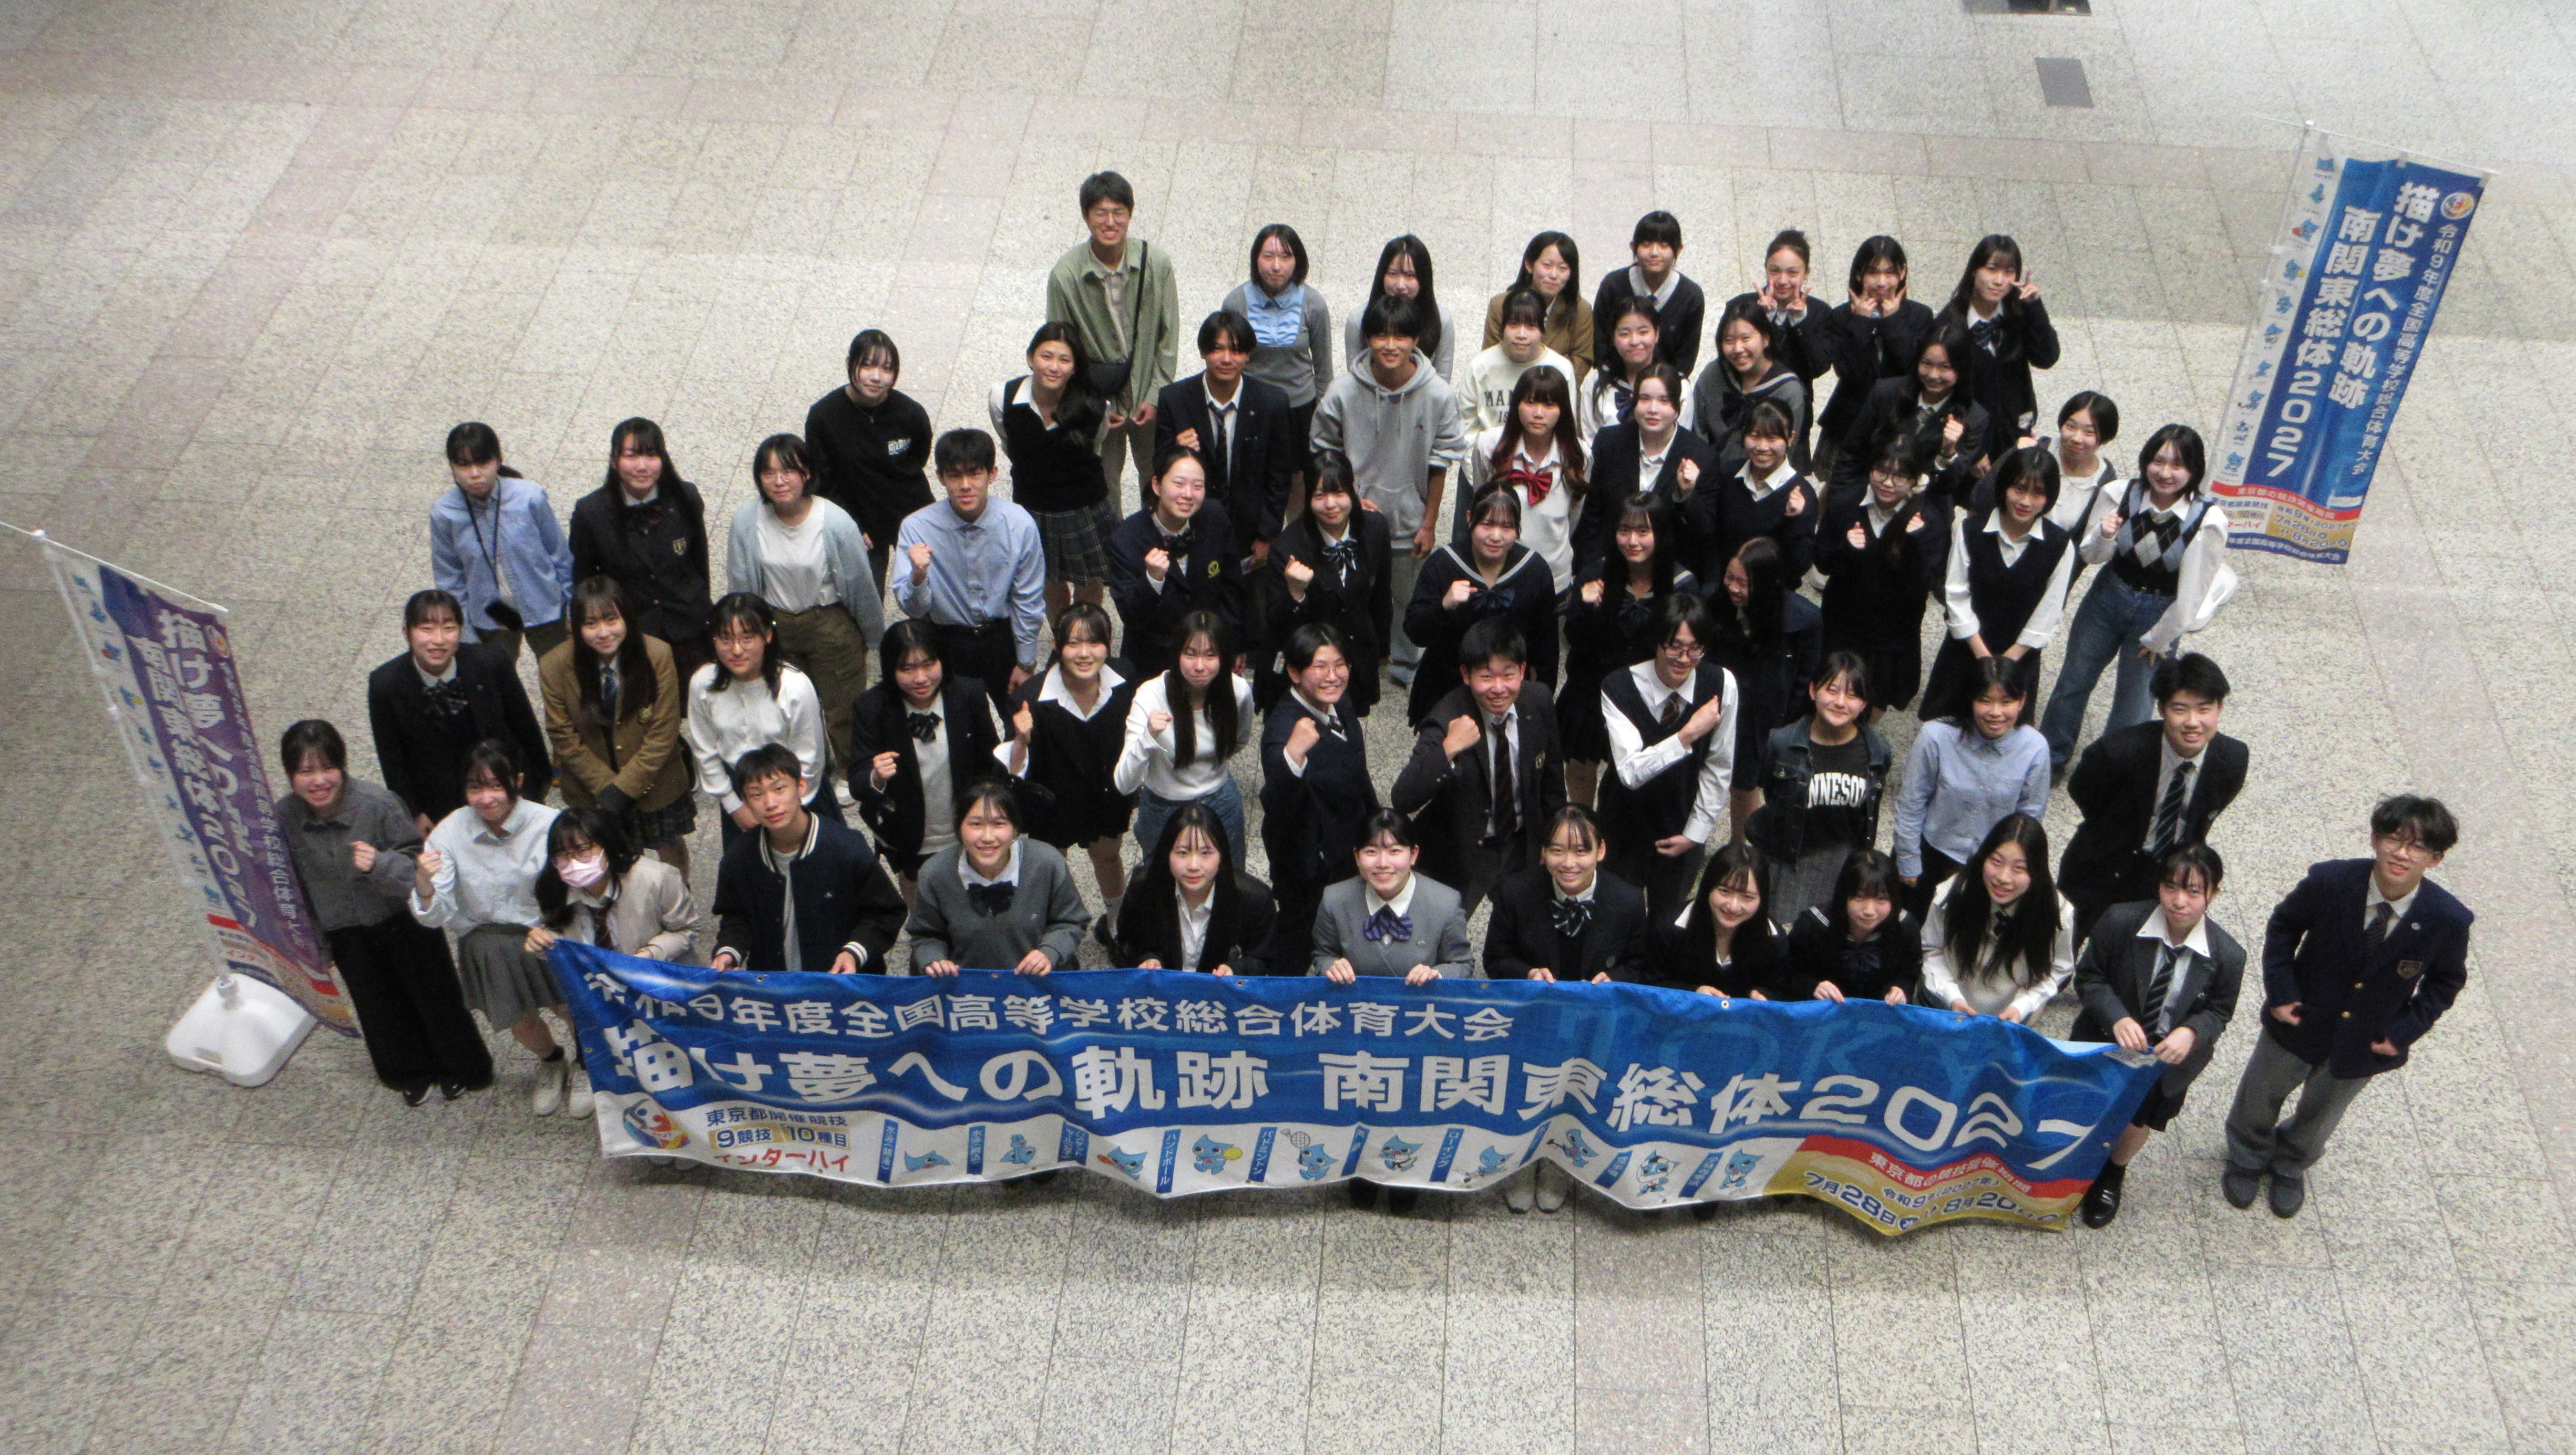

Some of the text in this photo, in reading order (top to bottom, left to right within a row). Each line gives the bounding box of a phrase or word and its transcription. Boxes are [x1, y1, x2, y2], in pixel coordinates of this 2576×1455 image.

[2266, 207, 2383, 478] 南関東総体2027
[2328, 181, 2440, 410] 描け夢への軌跡
[604, 1018, 2098, 1170] 描け夢への軌跡 南関東総体2027
[706, 1107, 848, 1127] 東京都開催競技
[717, 1125, 847, 1148] 9競技 10種目
[1159, 1133, 1176, 1185] ハンドボール
